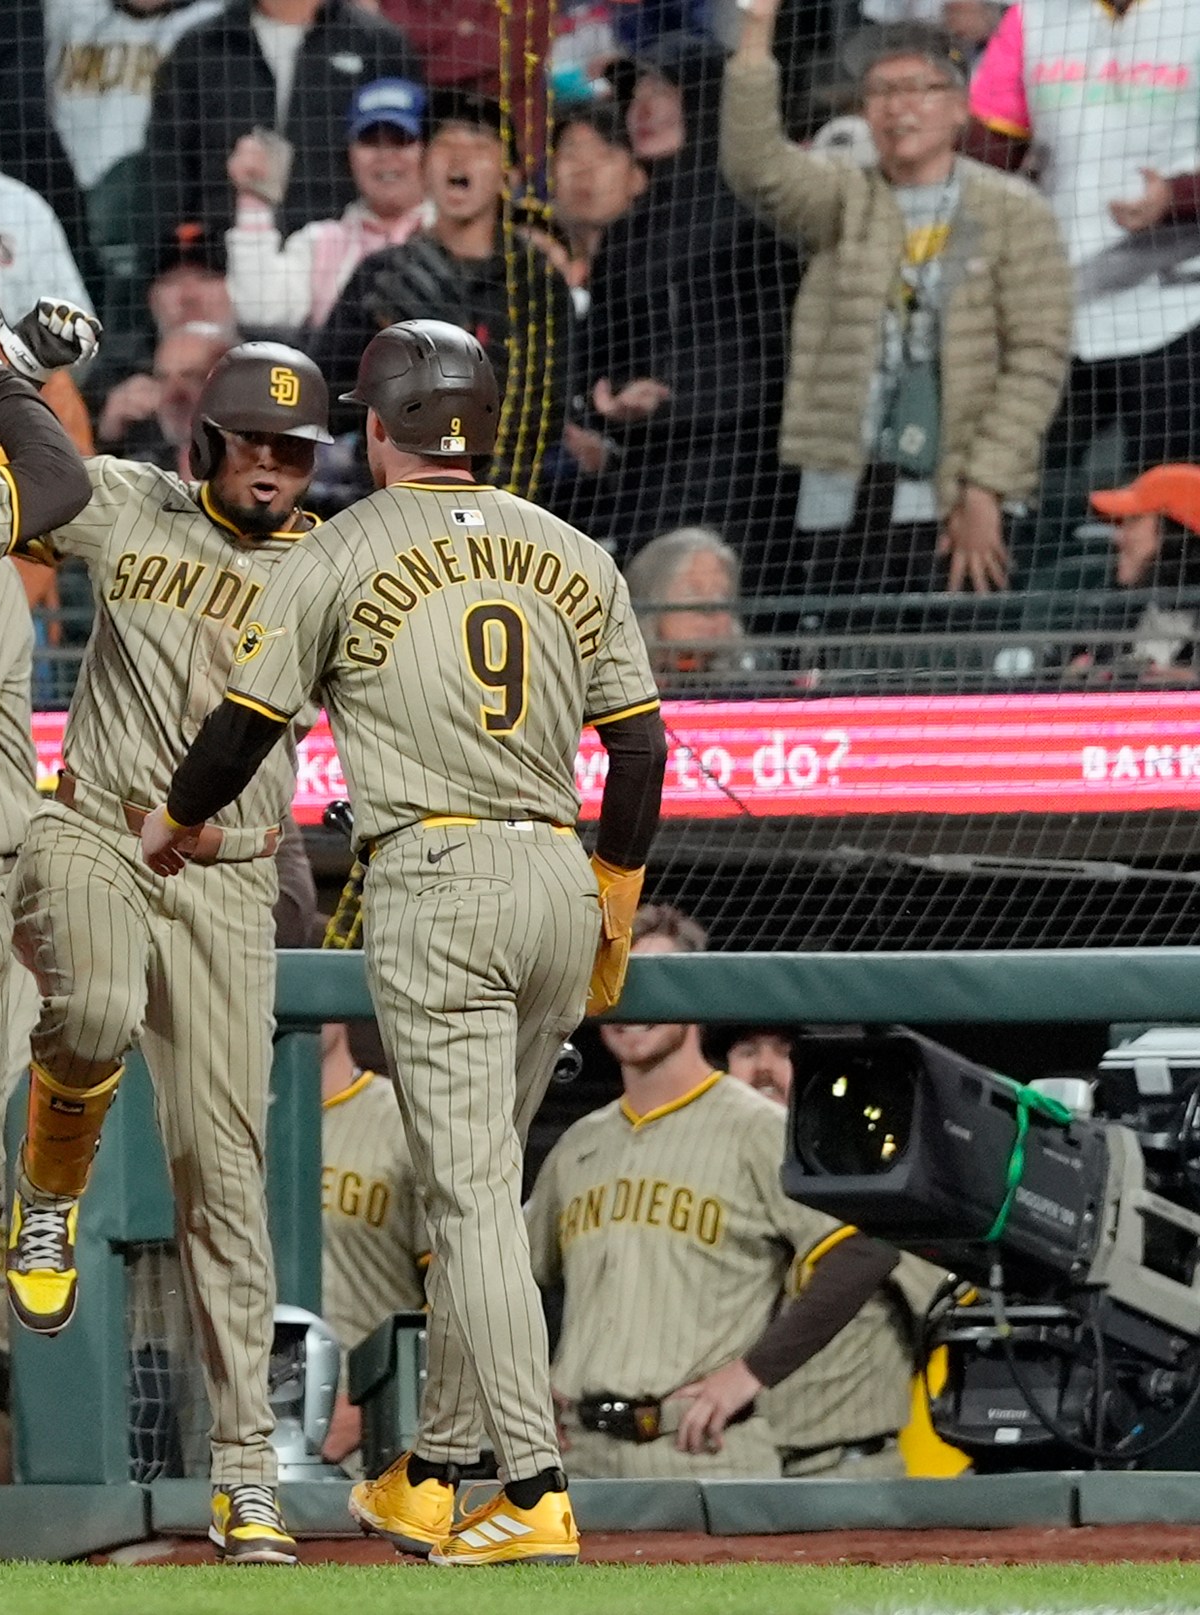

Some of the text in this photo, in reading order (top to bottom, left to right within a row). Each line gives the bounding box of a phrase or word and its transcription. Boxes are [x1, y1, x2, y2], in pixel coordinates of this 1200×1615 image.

[270, 366, 300, 407] SD
[450, 417, 461, 436] 9
[108, 551, 208, 612] SAN
[345, 534, 604, 668] CRONENWORTH
[461, 599, 530, 736] 9
[673, 730, 849, 790] to do?
[322, 1166, 390, 1228] EGO
[611, 1178, 721, 1245] DIEGO
